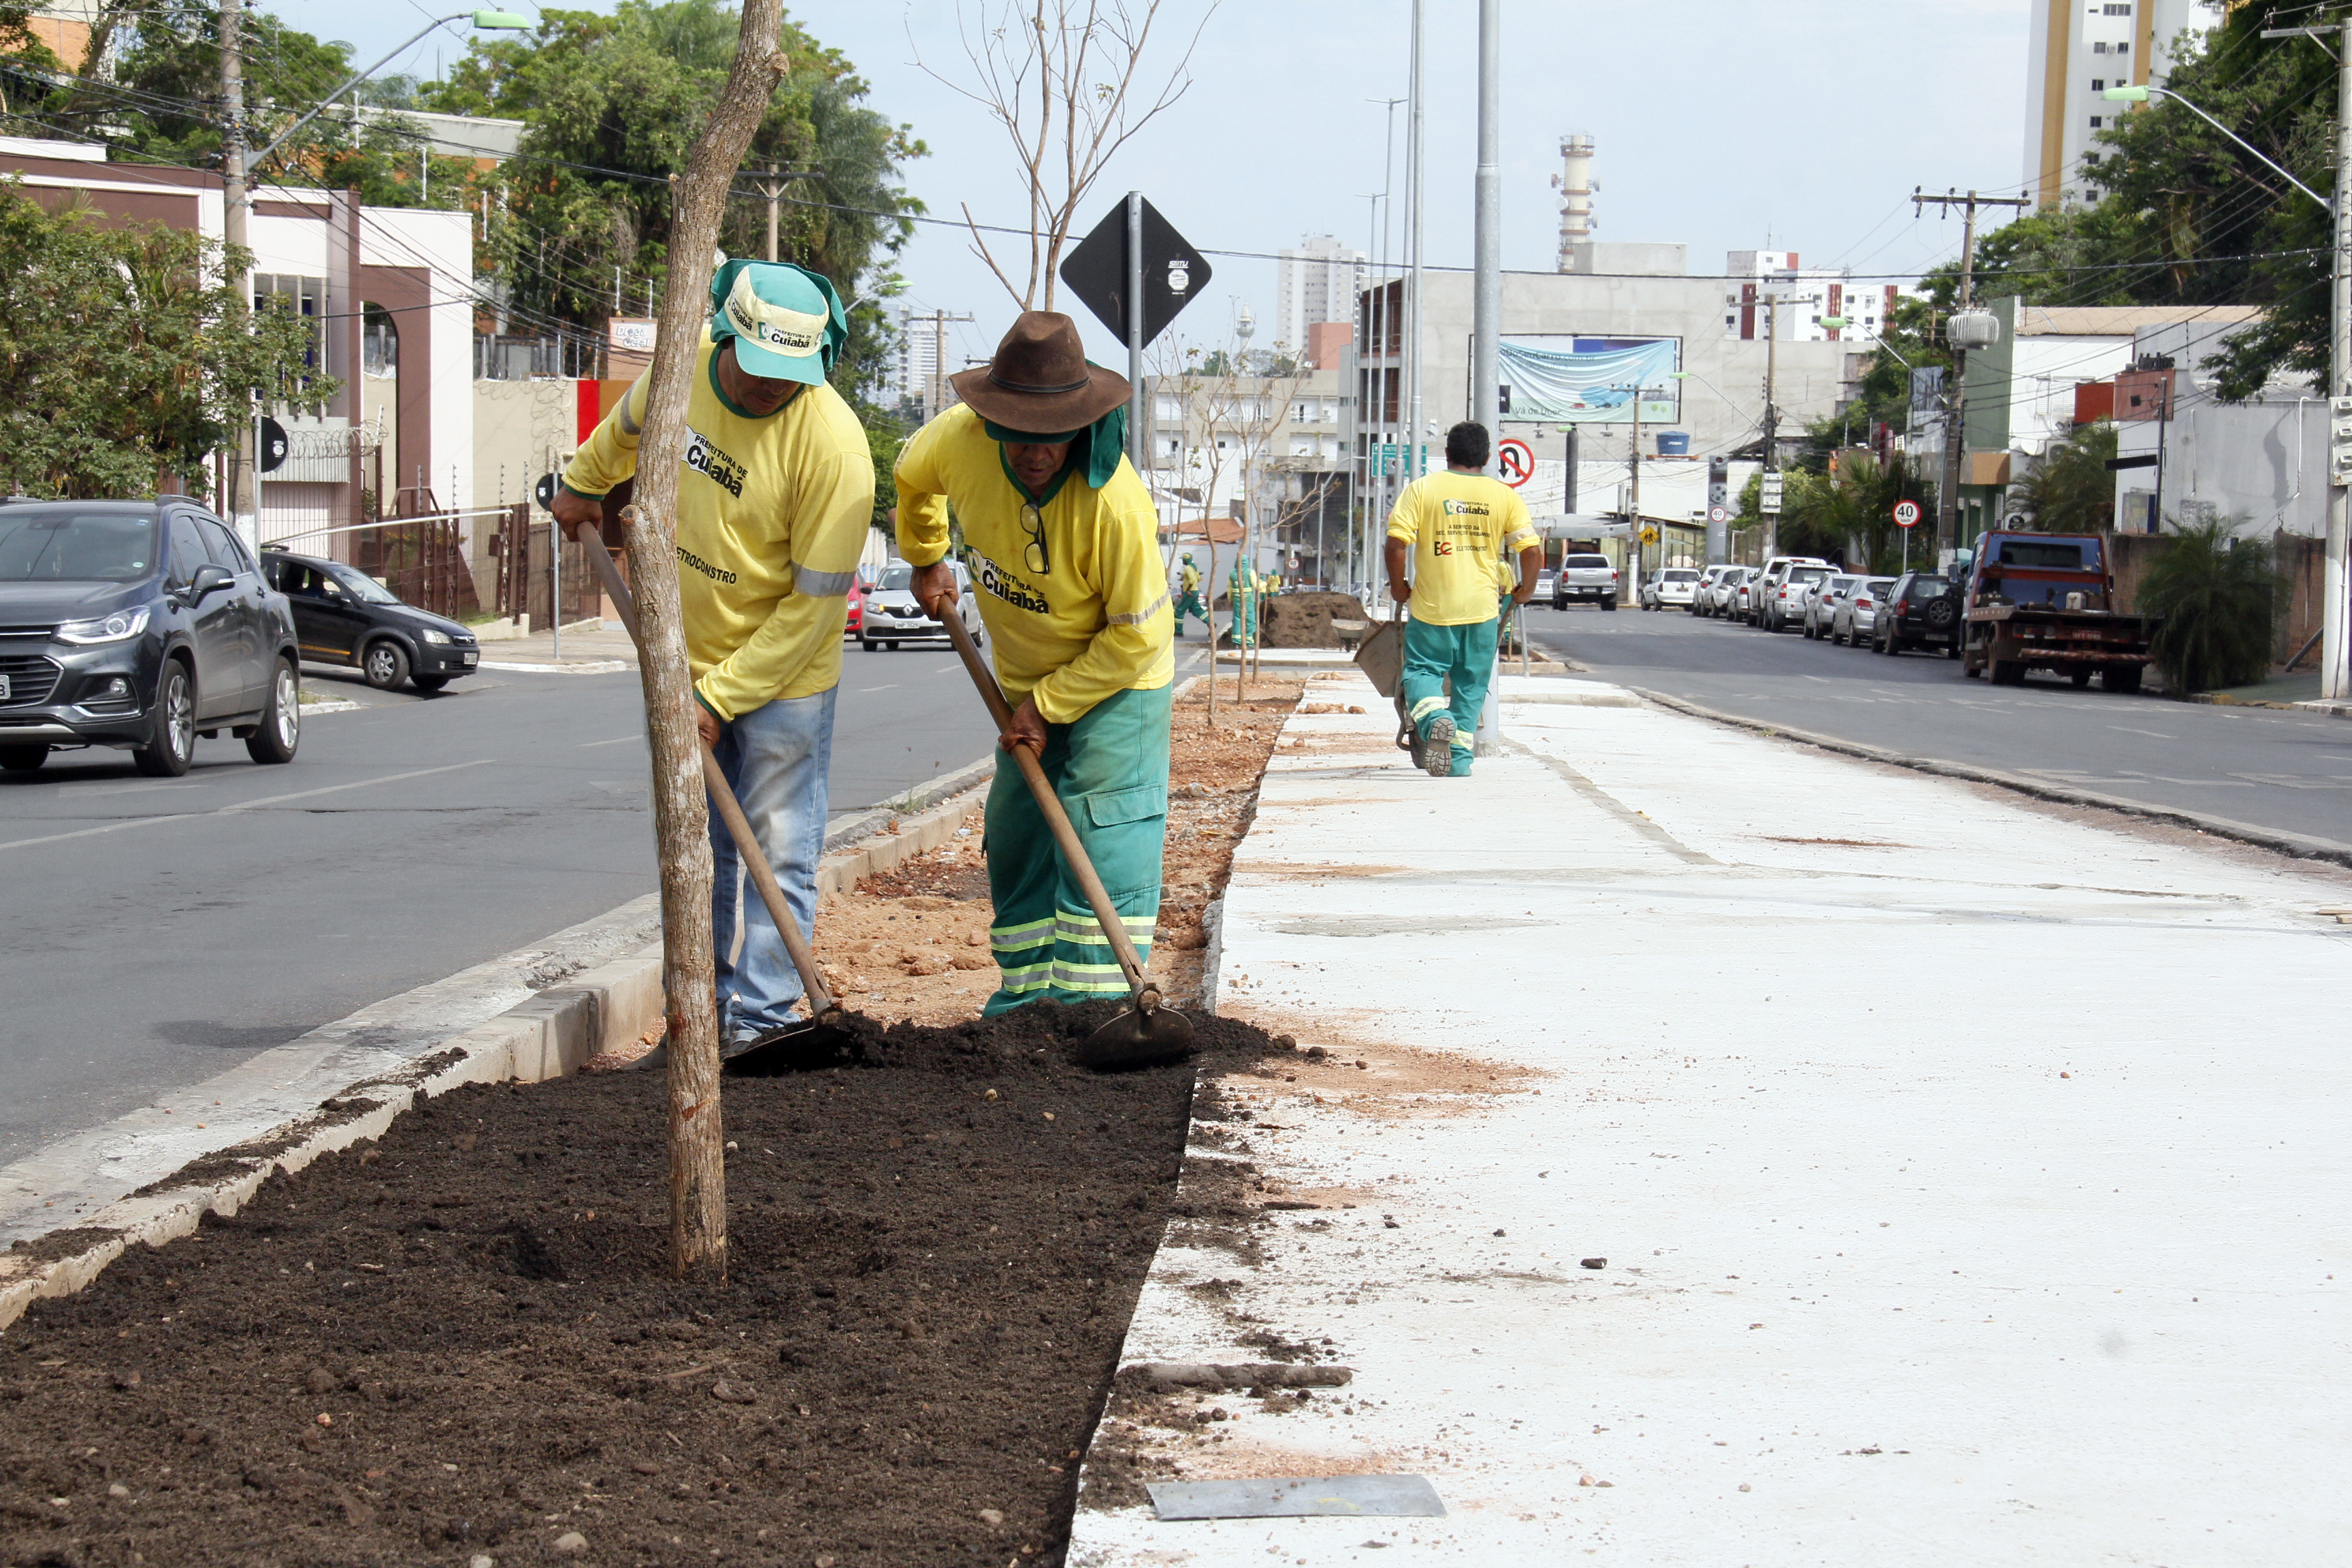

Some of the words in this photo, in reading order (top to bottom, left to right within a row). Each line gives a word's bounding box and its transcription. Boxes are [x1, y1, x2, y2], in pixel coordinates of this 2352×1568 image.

[731, 301, 753, 331] Cuiabá
[771, 333, 811, 348] Cuiabá
[774, 328, 805, 338] PREFEITURA
[687, 444, 742, 499] Cuiabá
[695, 435, 736, 469] PREFEITURA
[737, 466, 748, 478] DE
[1456, 505, 1489, 516] Cuiabá
[1897, 505, 1913, 517] 40
[676, 546, 736, 584] ETROCONSTRO
[985, 560, 1032, 591] PREFEITURA
